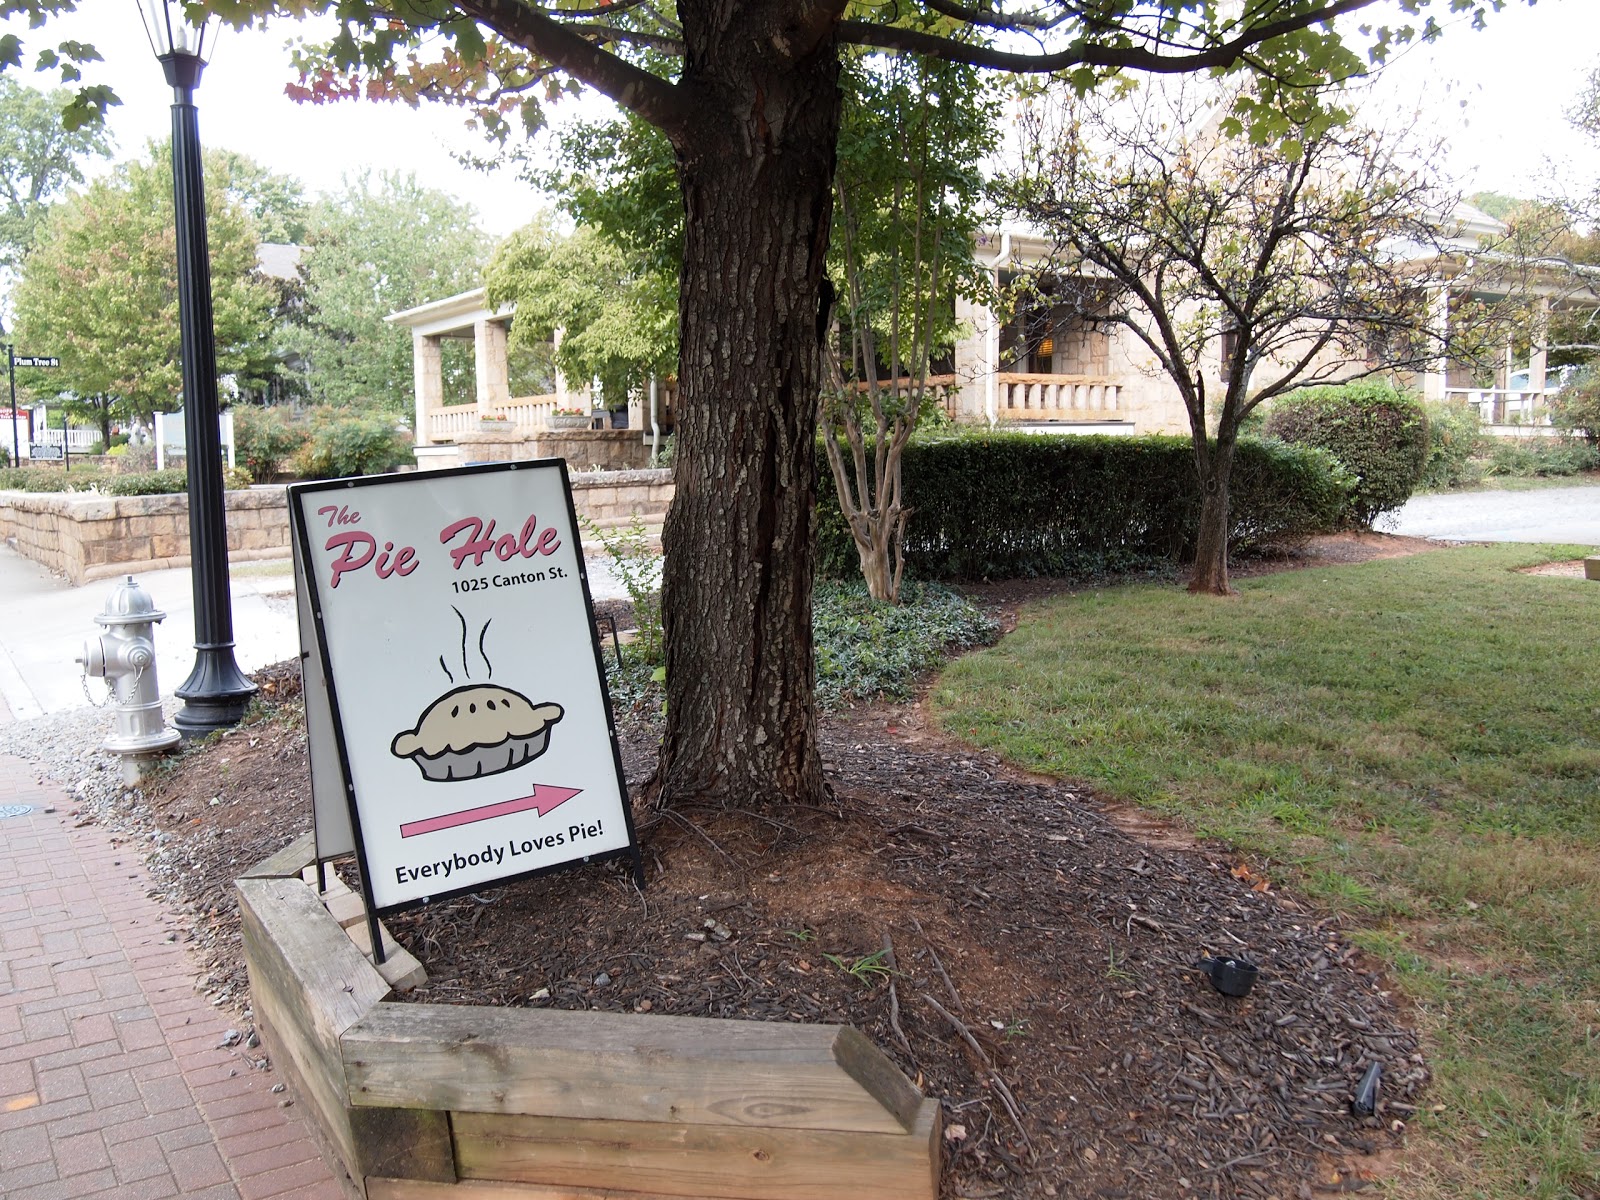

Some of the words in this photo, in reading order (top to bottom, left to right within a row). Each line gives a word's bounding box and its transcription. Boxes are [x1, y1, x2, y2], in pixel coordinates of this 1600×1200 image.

[14, 358, 32, 366] Plum
[33, 358, 50, 366] Tree
[50, 358, 59, 367] St
[318, 505, 361, 528] The
[325, 531, 420, 589] Pie
[440, 514, 561, 570] Hole
[452, 577, 489, 594] 1025
[492, 570, 545, 588] Canton
[548, 567, 568, 580] St.
[395, 845, 504, 884] Everybody
[509, 832, 565, 857] Loves
[569, 820, 604, 842] Pie!
